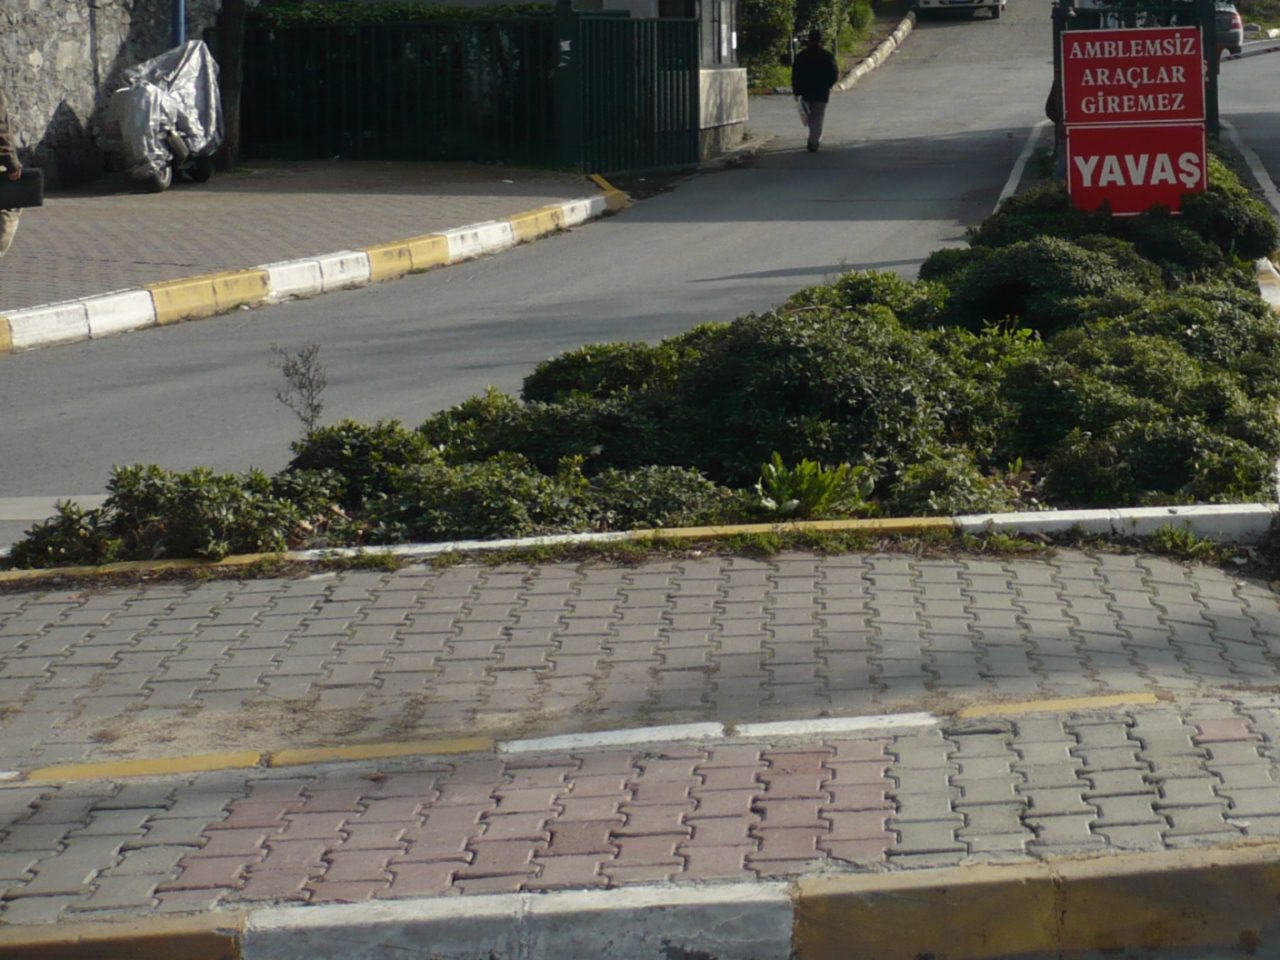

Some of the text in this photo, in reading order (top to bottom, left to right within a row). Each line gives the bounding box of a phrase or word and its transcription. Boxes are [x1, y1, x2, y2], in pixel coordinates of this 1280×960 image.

[1069, 33, 1196, 59] AMBLEMSİZ
[1081, 66, 1186, 88] ARAÇLAR
[1081, 91, 1185, 114] GİREMEZ
[1074, 152, 1200, 189] YAVAŞ
